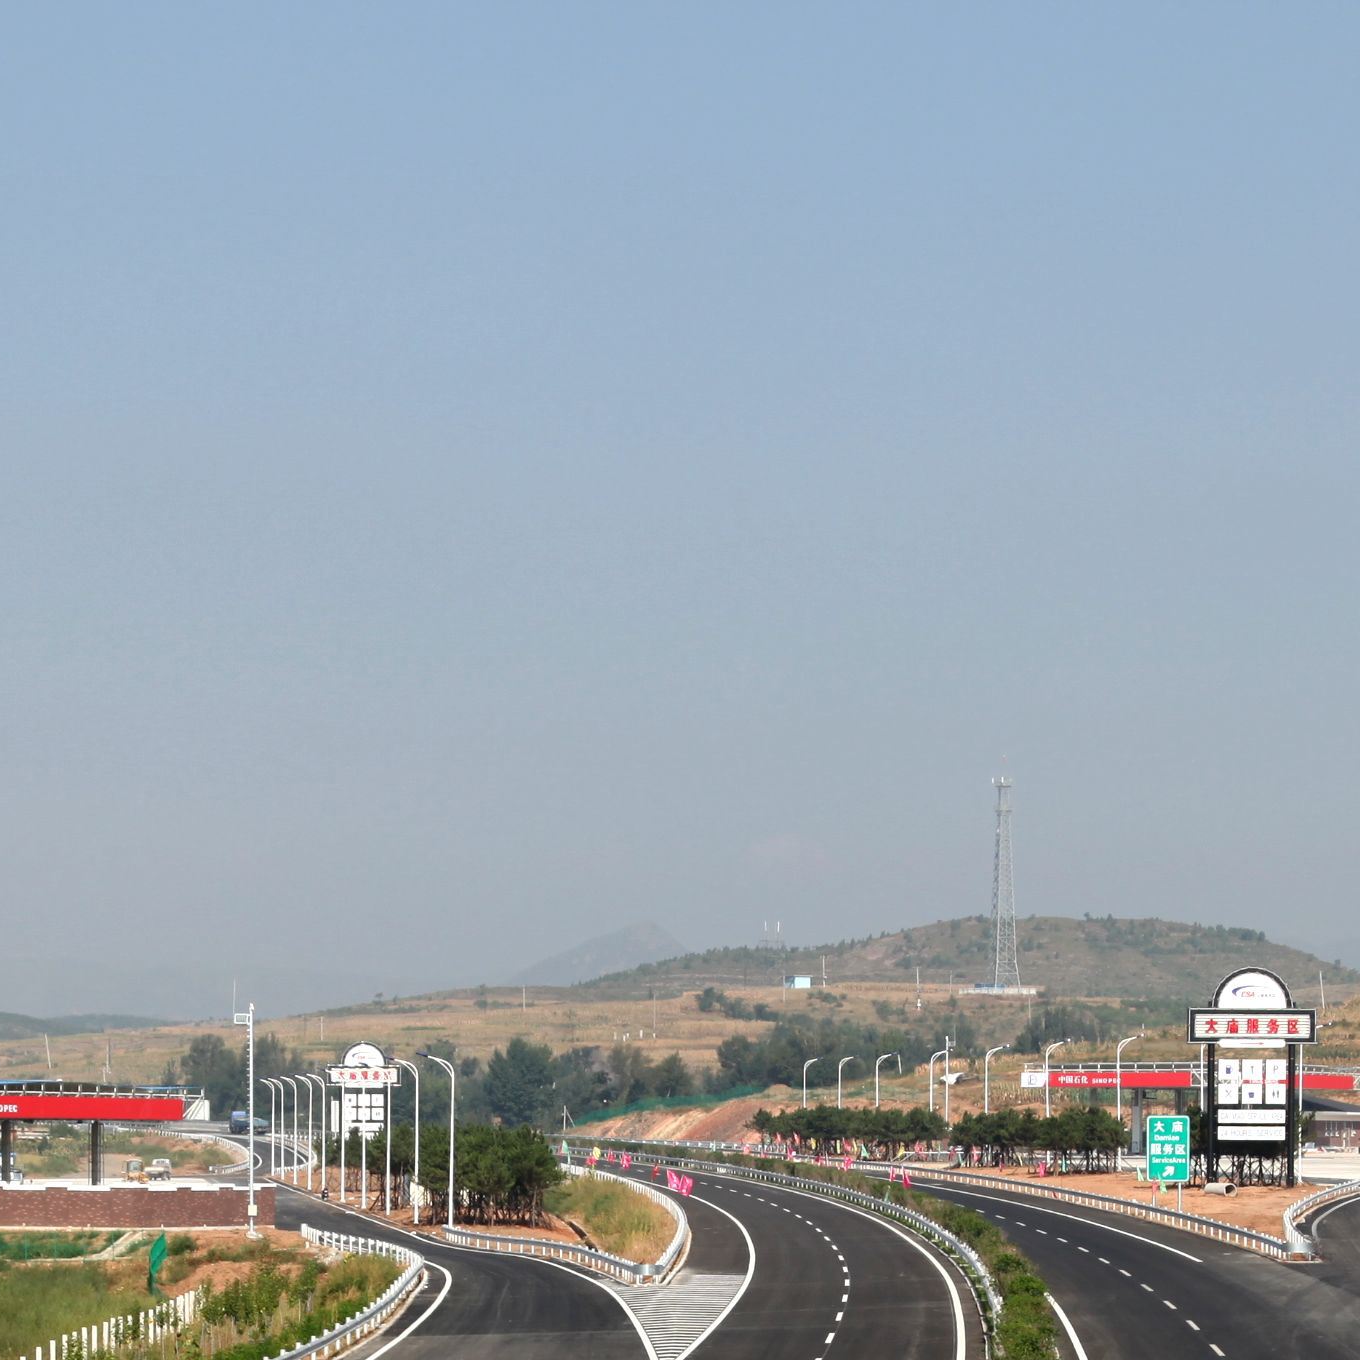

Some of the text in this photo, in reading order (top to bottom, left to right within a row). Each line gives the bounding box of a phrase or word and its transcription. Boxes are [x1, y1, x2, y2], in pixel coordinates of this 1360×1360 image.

[1205, 1018, 1300, 1034] 大庙服务区
[1058, 1075, 1088, 1084] 中国石化
[1153, 1120, 1184, 1133] 大庙
[1150, 1143, 1186, 1155] 服务区
